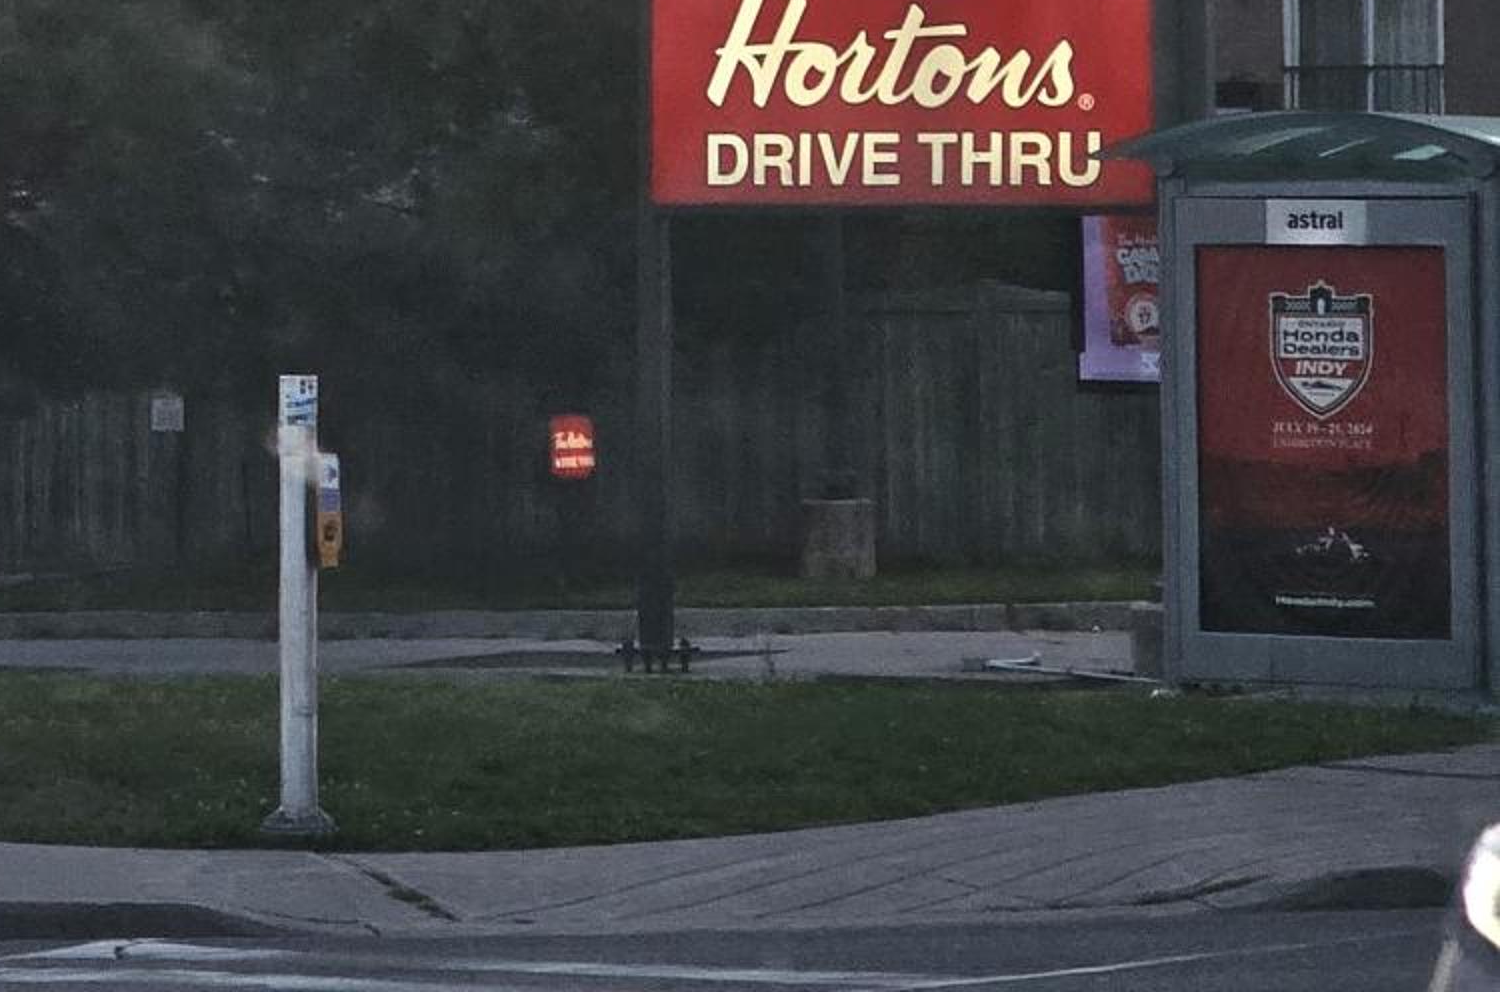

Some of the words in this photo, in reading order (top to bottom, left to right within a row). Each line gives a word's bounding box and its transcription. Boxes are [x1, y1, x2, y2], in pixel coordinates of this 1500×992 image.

[706, 132, 900, 187] DRIVE
[917, 130, 1102, 187] THRU
[1287, 210, 1343, 230] astral
[1283, 328, 1360, 343] Honda
[1283, 343, 1360, 357] Dealers
[1295, 360, 1348, 377] INDY
